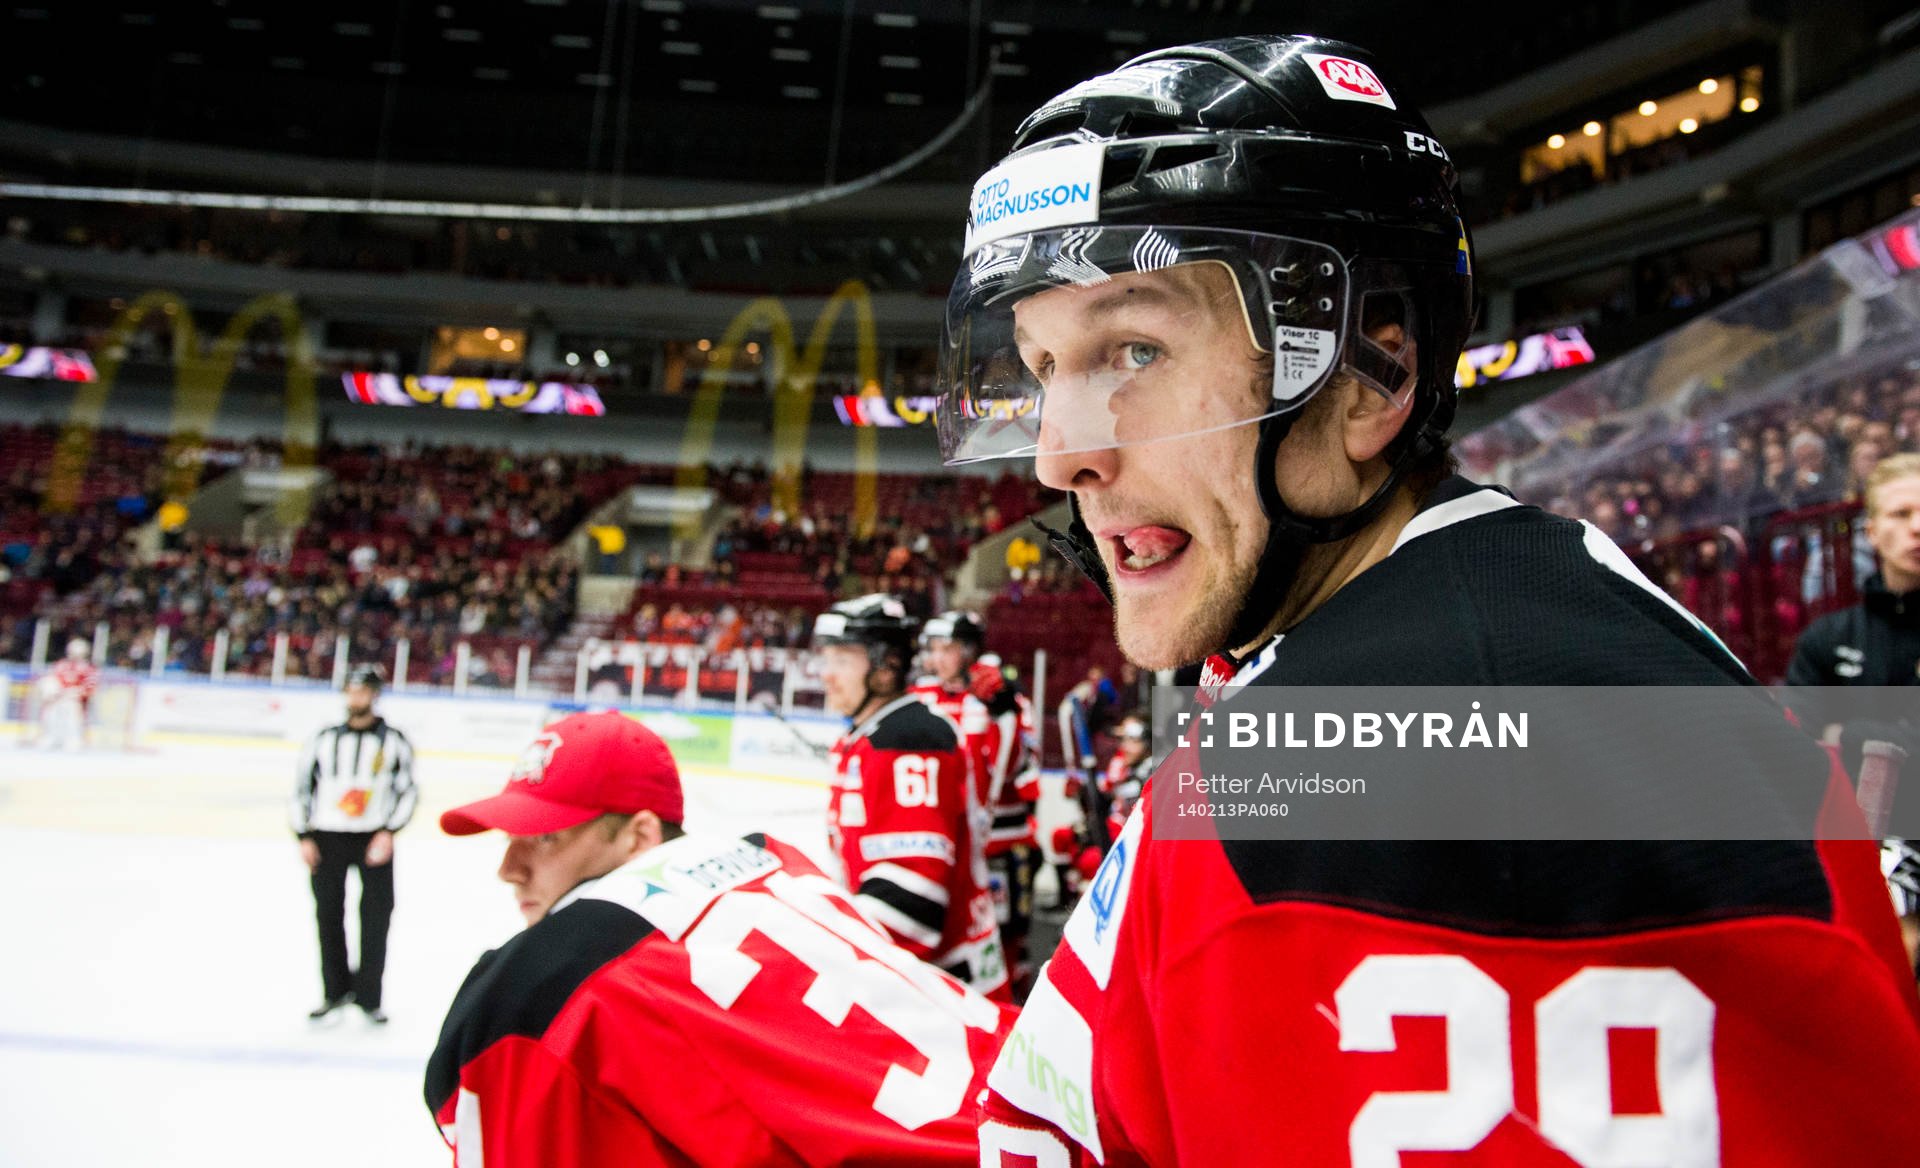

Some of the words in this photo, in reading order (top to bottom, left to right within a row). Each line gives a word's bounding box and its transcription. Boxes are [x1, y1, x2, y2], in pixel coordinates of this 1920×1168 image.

[1325, 59, 1384, 95] AXA
[1403, 131, 1451, 162] CC
[975, 182, 1091, 227] MAGNUSSON
[978, 178, 1009, 209] OTTO
[1281, 328, 1305, 338] Visor
[1308, 332, 1320, 340] 1C
[893, 754, 940, 808] 61
[1334, 954, 1722, 1168] 29
